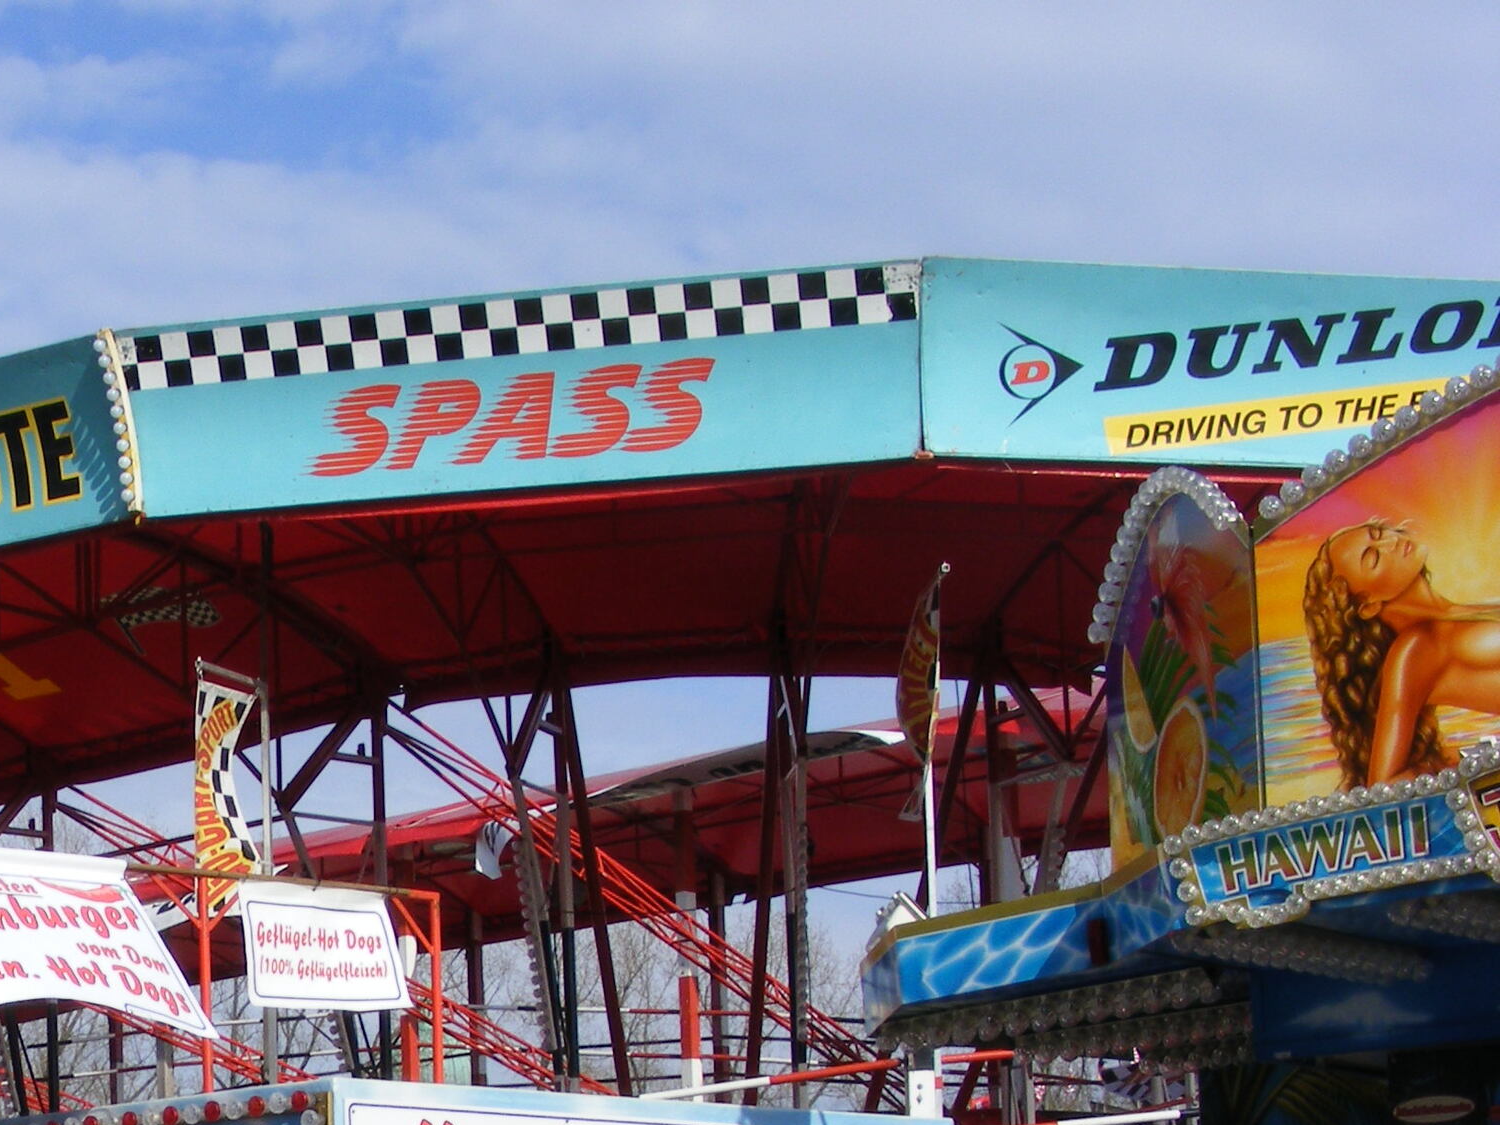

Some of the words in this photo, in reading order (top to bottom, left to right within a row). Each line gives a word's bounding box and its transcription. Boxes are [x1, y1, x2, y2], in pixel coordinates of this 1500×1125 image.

[300, 357, 717, 478] SPASS
[1126, 408, 1267, 449] DRIVING
[1280, 403, 1323, 430] TO
[1335, 394, 1399, 422] THE
[1215, 803, 1432, 894] HAWAII
[77, 942, 120, 961] vom
[122, 945, 171, 975] Dom
[256, 920, 340, 950] Geflügel-Hot
[345, 929, 382, 954] Dogs
[47, 954, 110, 988] Hot
[112, 965, 192, 1017] Dogs
[259, 955, 294, 977] (100%
[297, 959, 389, 982] Geflügelfleisch)
